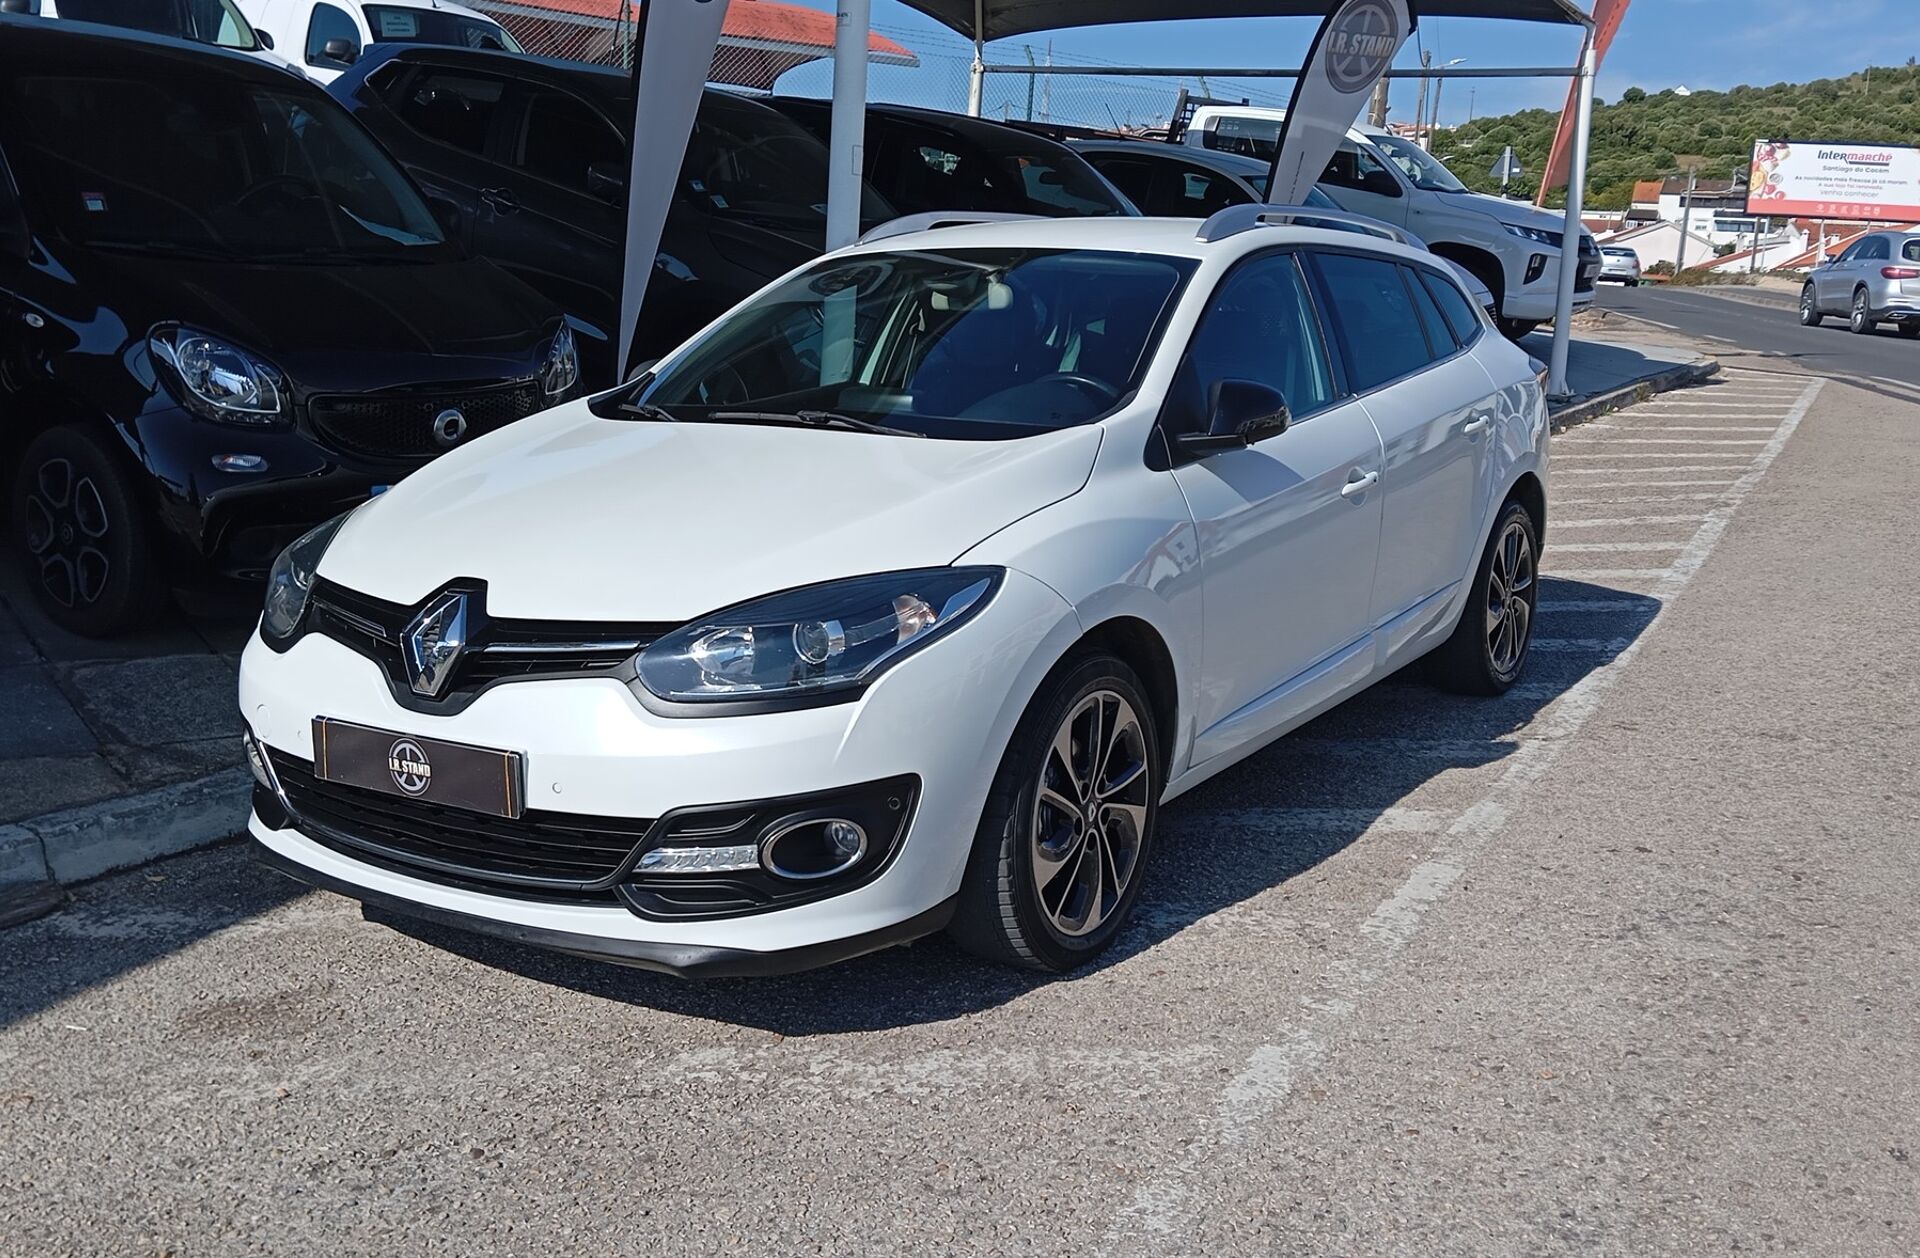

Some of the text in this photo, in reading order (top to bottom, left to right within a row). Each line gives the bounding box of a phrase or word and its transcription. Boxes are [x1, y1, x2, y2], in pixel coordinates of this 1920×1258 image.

[1349, 34, 1395, 57] STAND
[1817, 149, 1893, 163] Intermarché
[1822, 165, 1853, 173] Santiago
[402, 759, 431, 777] STAND
